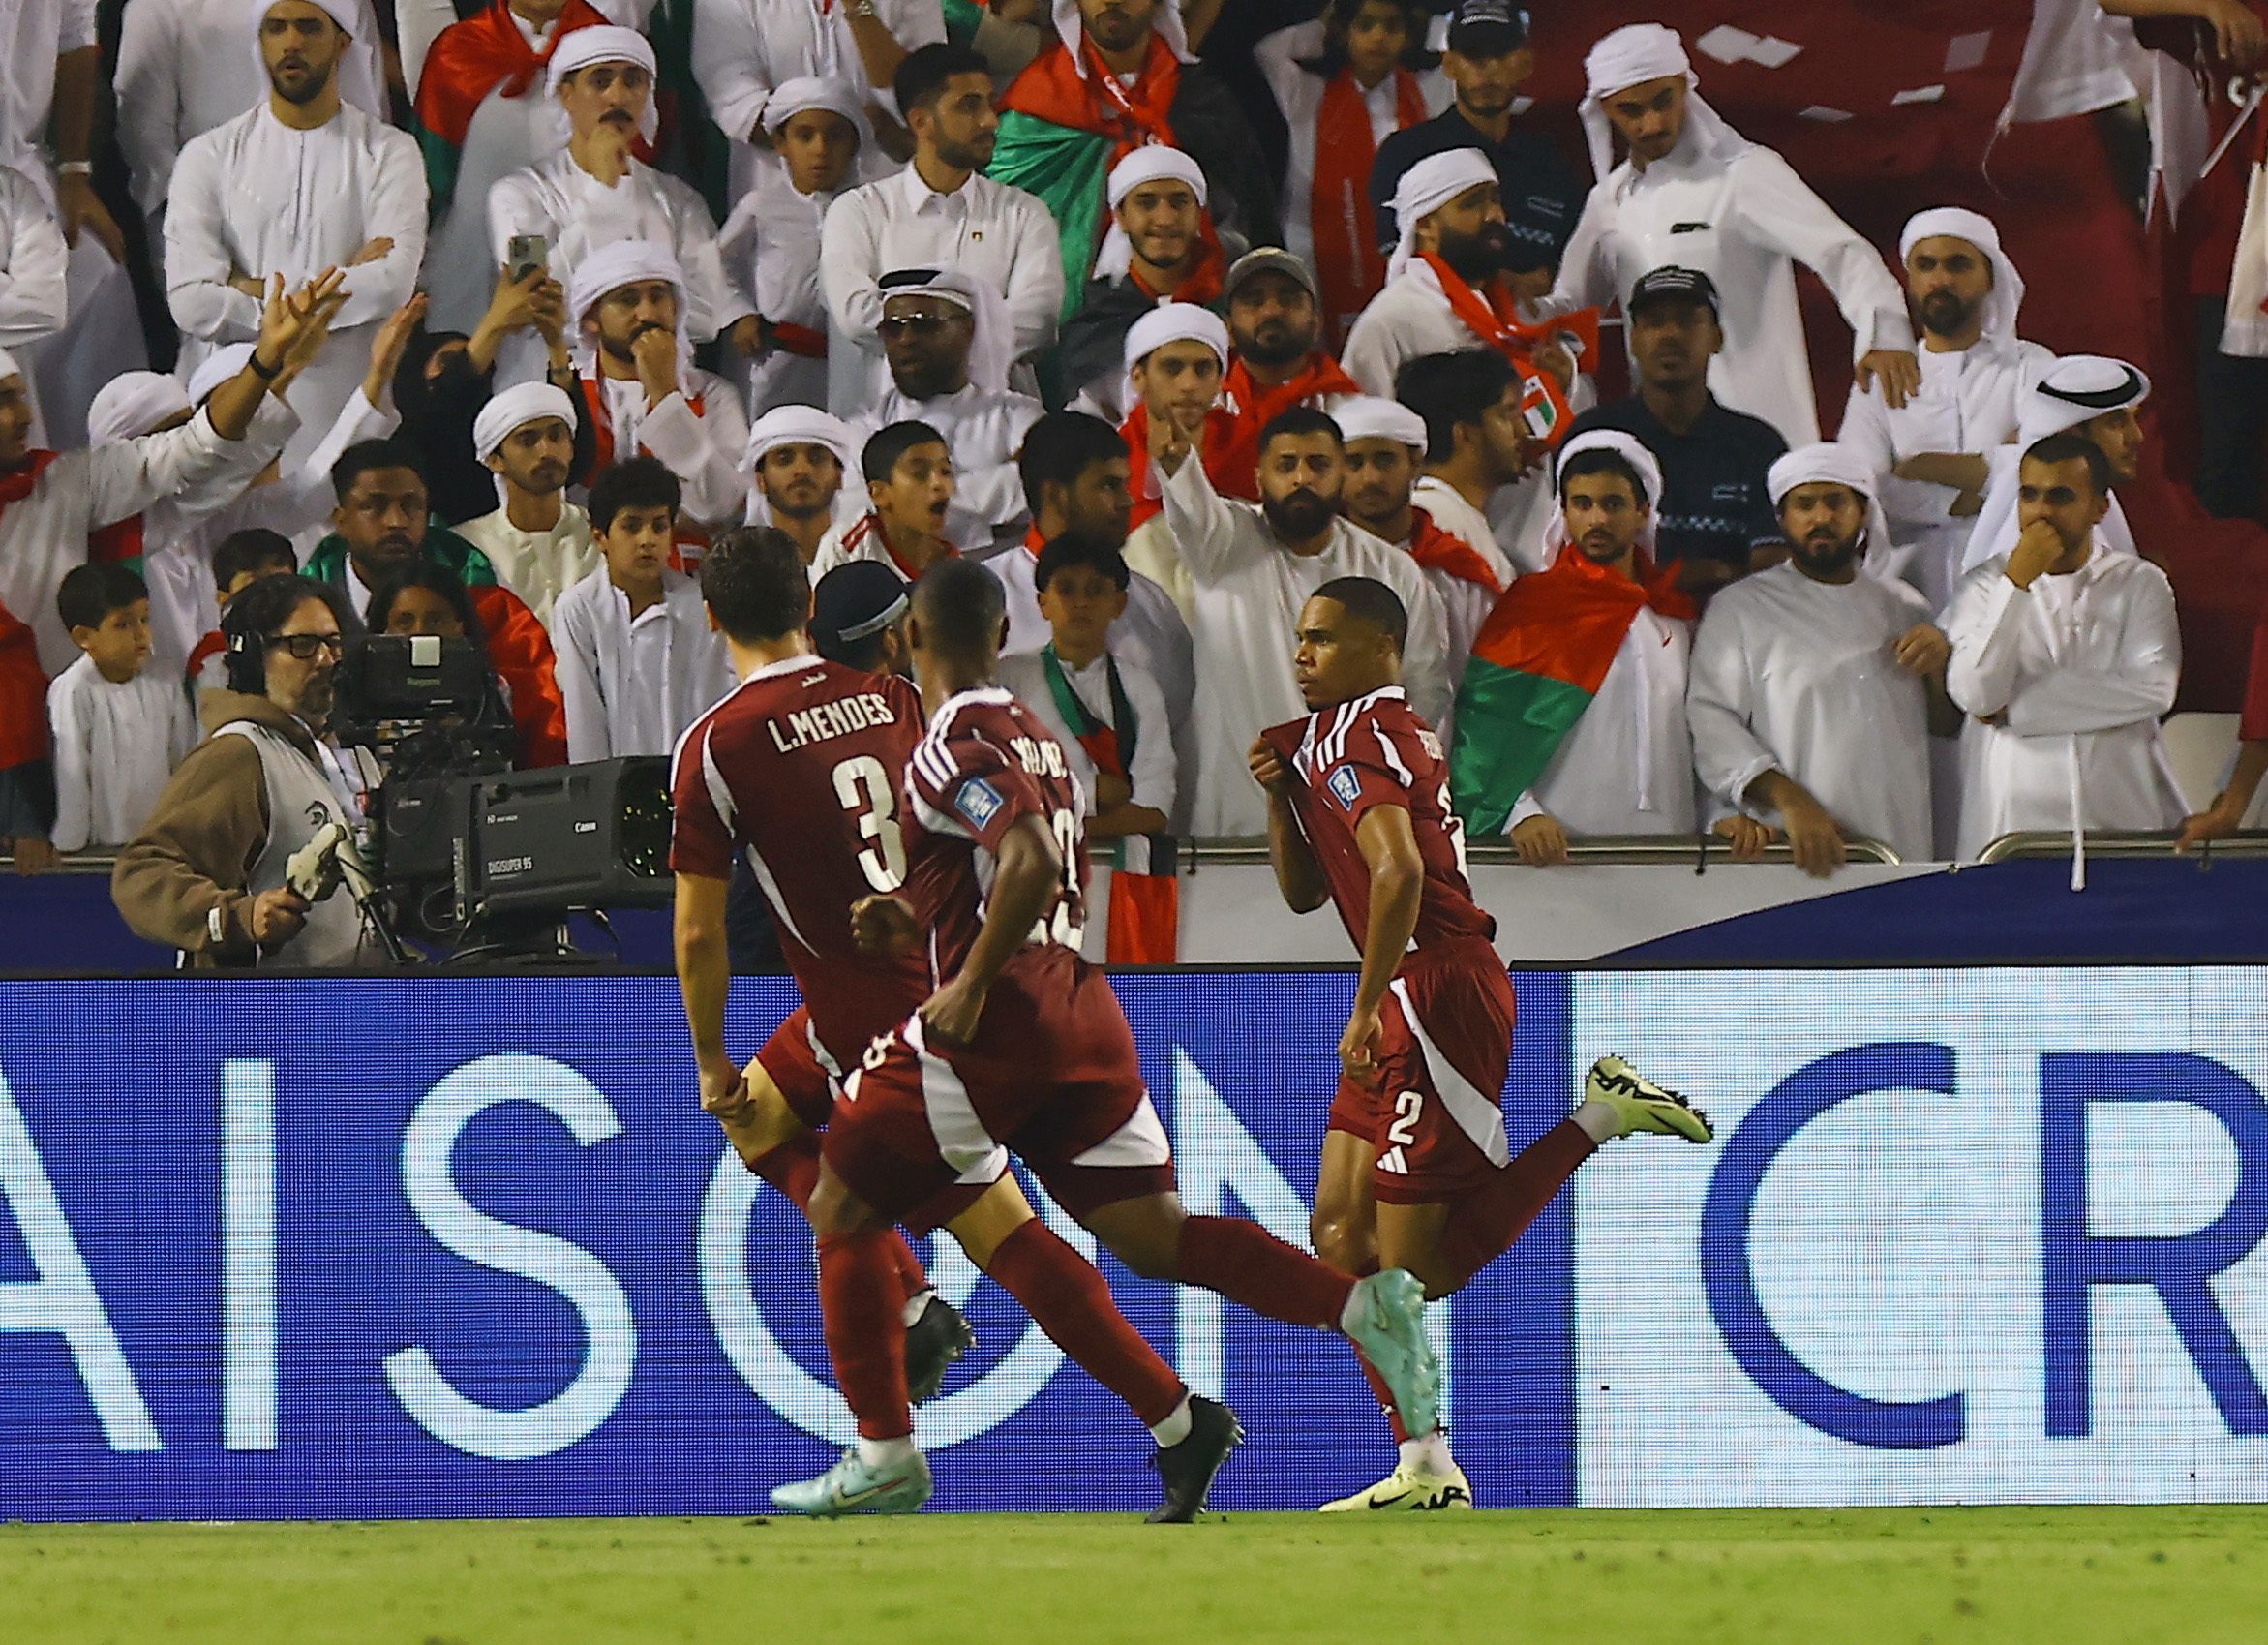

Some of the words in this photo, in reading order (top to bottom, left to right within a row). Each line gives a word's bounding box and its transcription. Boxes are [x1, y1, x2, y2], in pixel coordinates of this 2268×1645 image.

[768, 693, 895, 753] L.MENDES
[832, 755, 908, 893] 3
[523, 856, 532, 870] 95
[1387, 1090, 1423, 1145] 2
